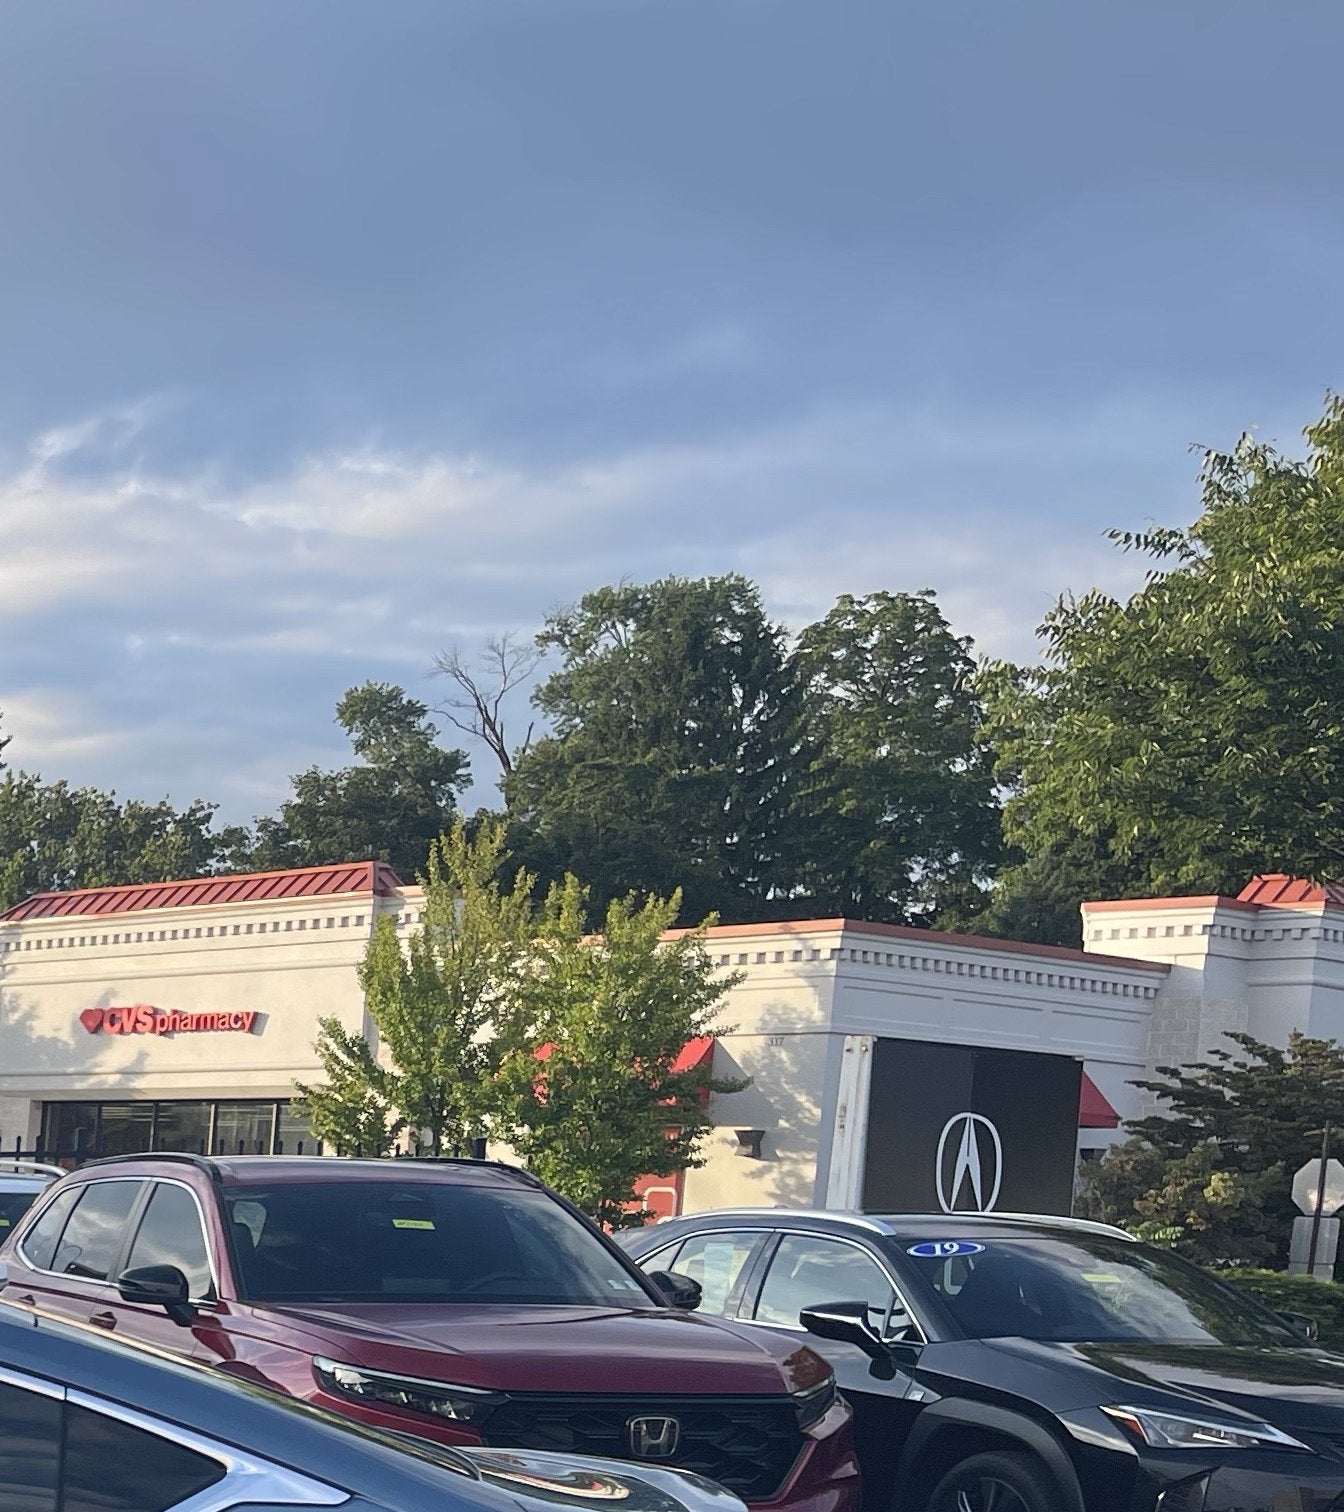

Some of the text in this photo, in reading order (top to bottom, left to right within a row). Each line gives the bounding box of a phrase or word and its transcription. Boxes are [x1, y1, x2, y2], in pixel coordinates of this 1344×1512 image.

[102, 1004, 255, 1037] CVS pharmacy
[767, 1036, 785, 1047] 317
[934, 1242, 960, 1256] 19
